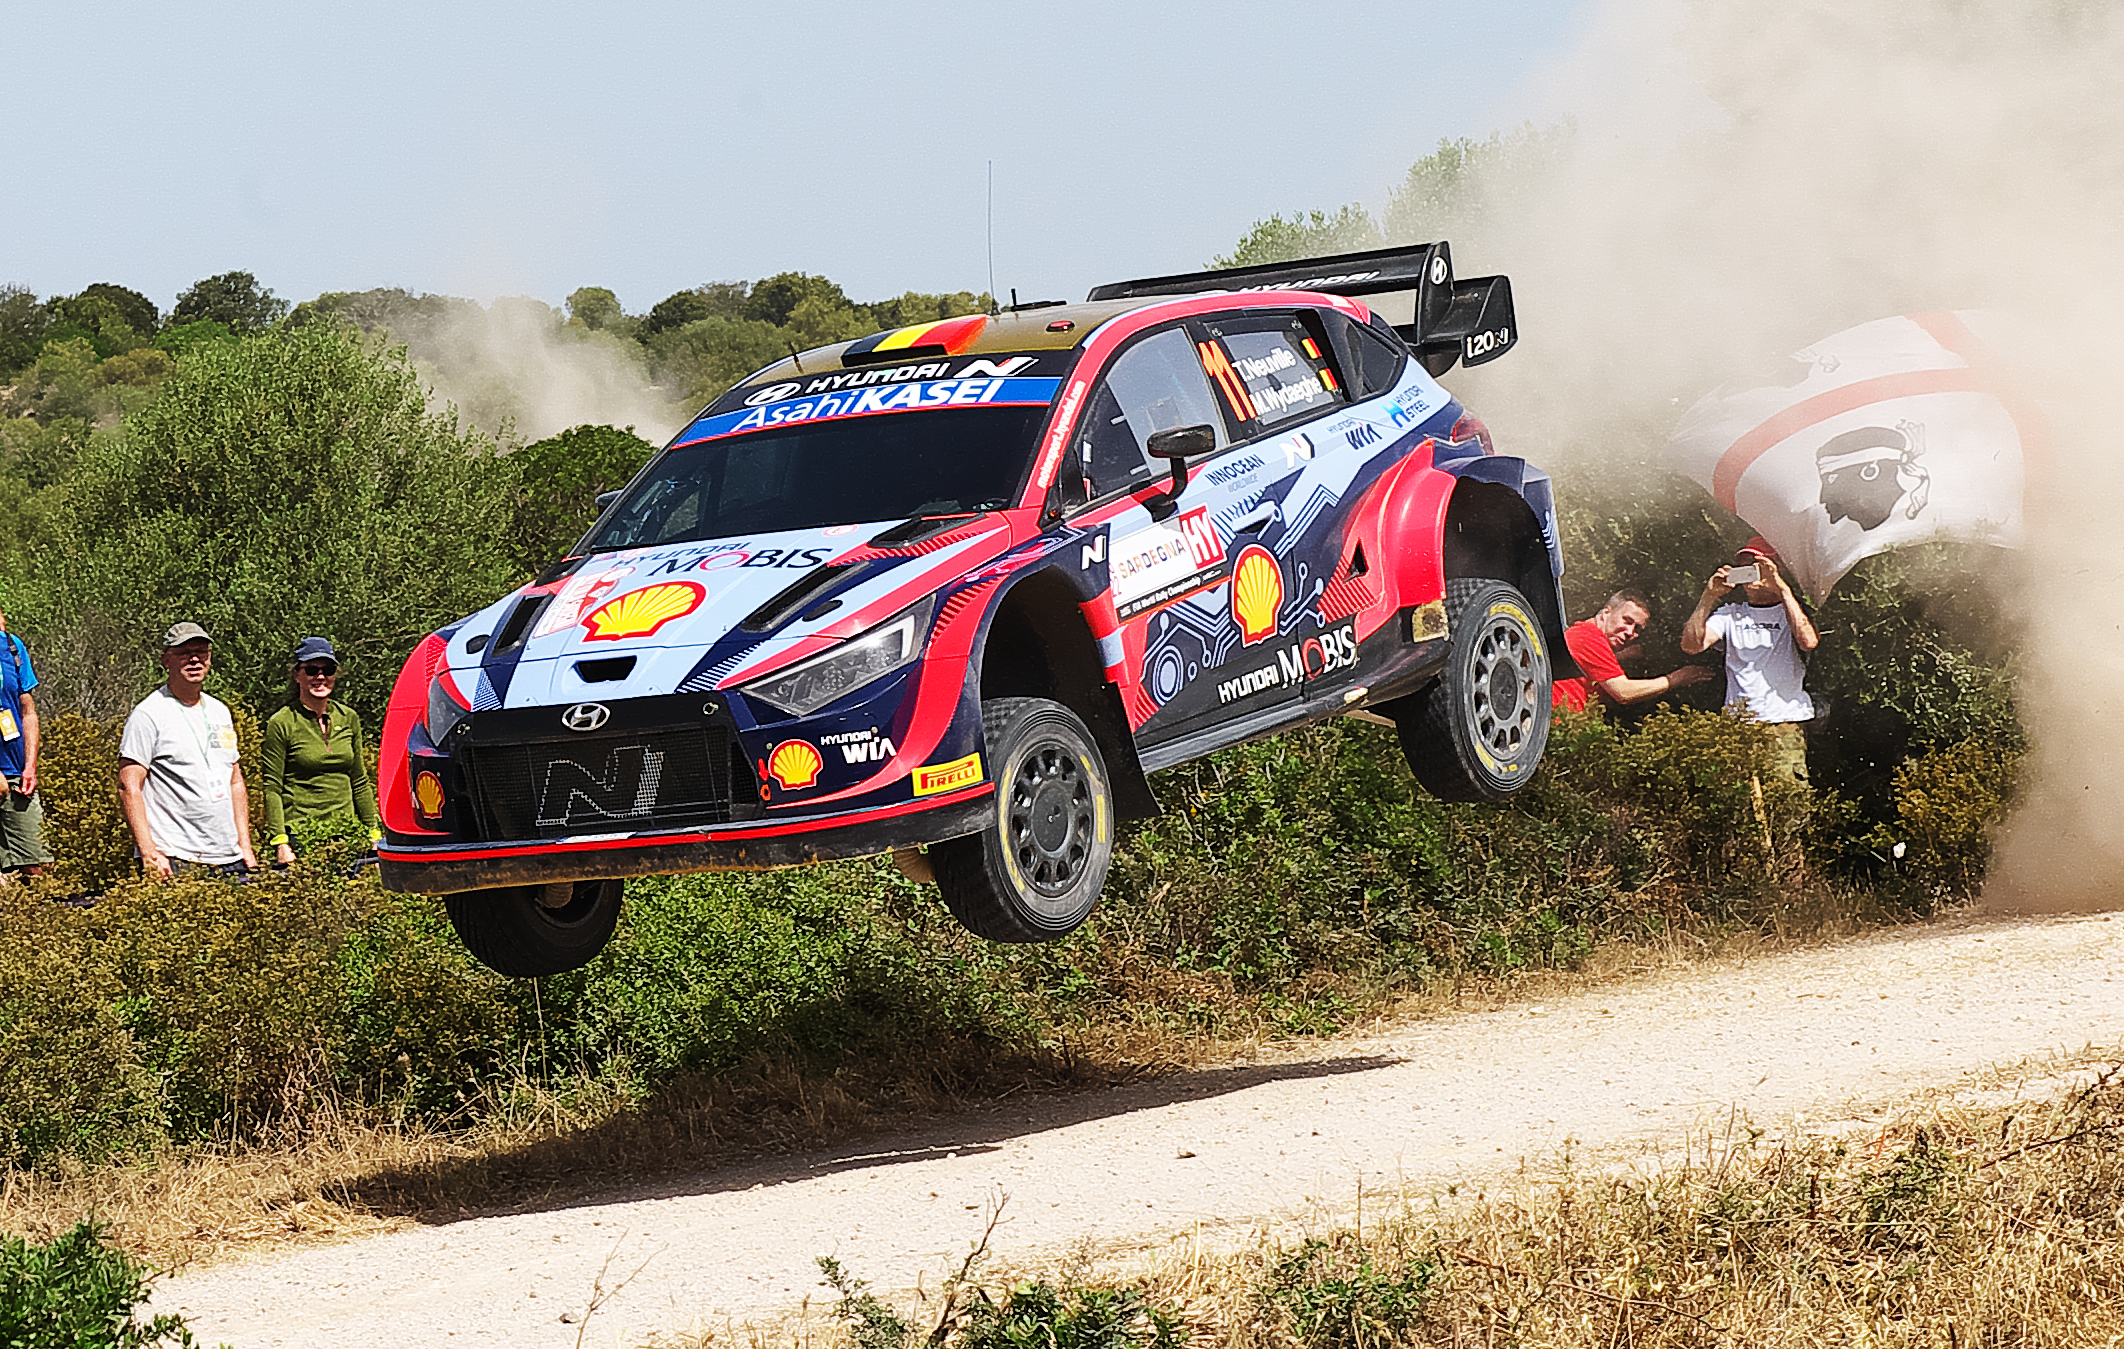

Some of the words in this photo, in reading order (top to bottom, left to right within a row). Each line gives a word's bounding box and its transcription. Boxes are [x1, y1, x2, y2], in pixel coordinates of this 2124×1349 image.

[804, 363, 951, 394] HYUNDAI
[1198, 339, 1257, 422] 11
[1231, 347, 1297, 382] T.Neuville
[1249, 375, 1324, 413] M.Wydaeghe
[1405, 400, 1431, 419] STEEL
[1204, 453, 1266, 487] INNOCEAN
[612, 541, 753, 568] HYUNDAI
[645, 548, 834, 577] MOBIS
[1117, 538, 1187, 579] SARDEGNA
[1217, 664, 1280, 704] HYUNDAI
[1276, 625, 1358, 689] MOBIS
[820, 730, 872, 746] HYUNDAI
[920, 760, 977, 790] PIRELLI
